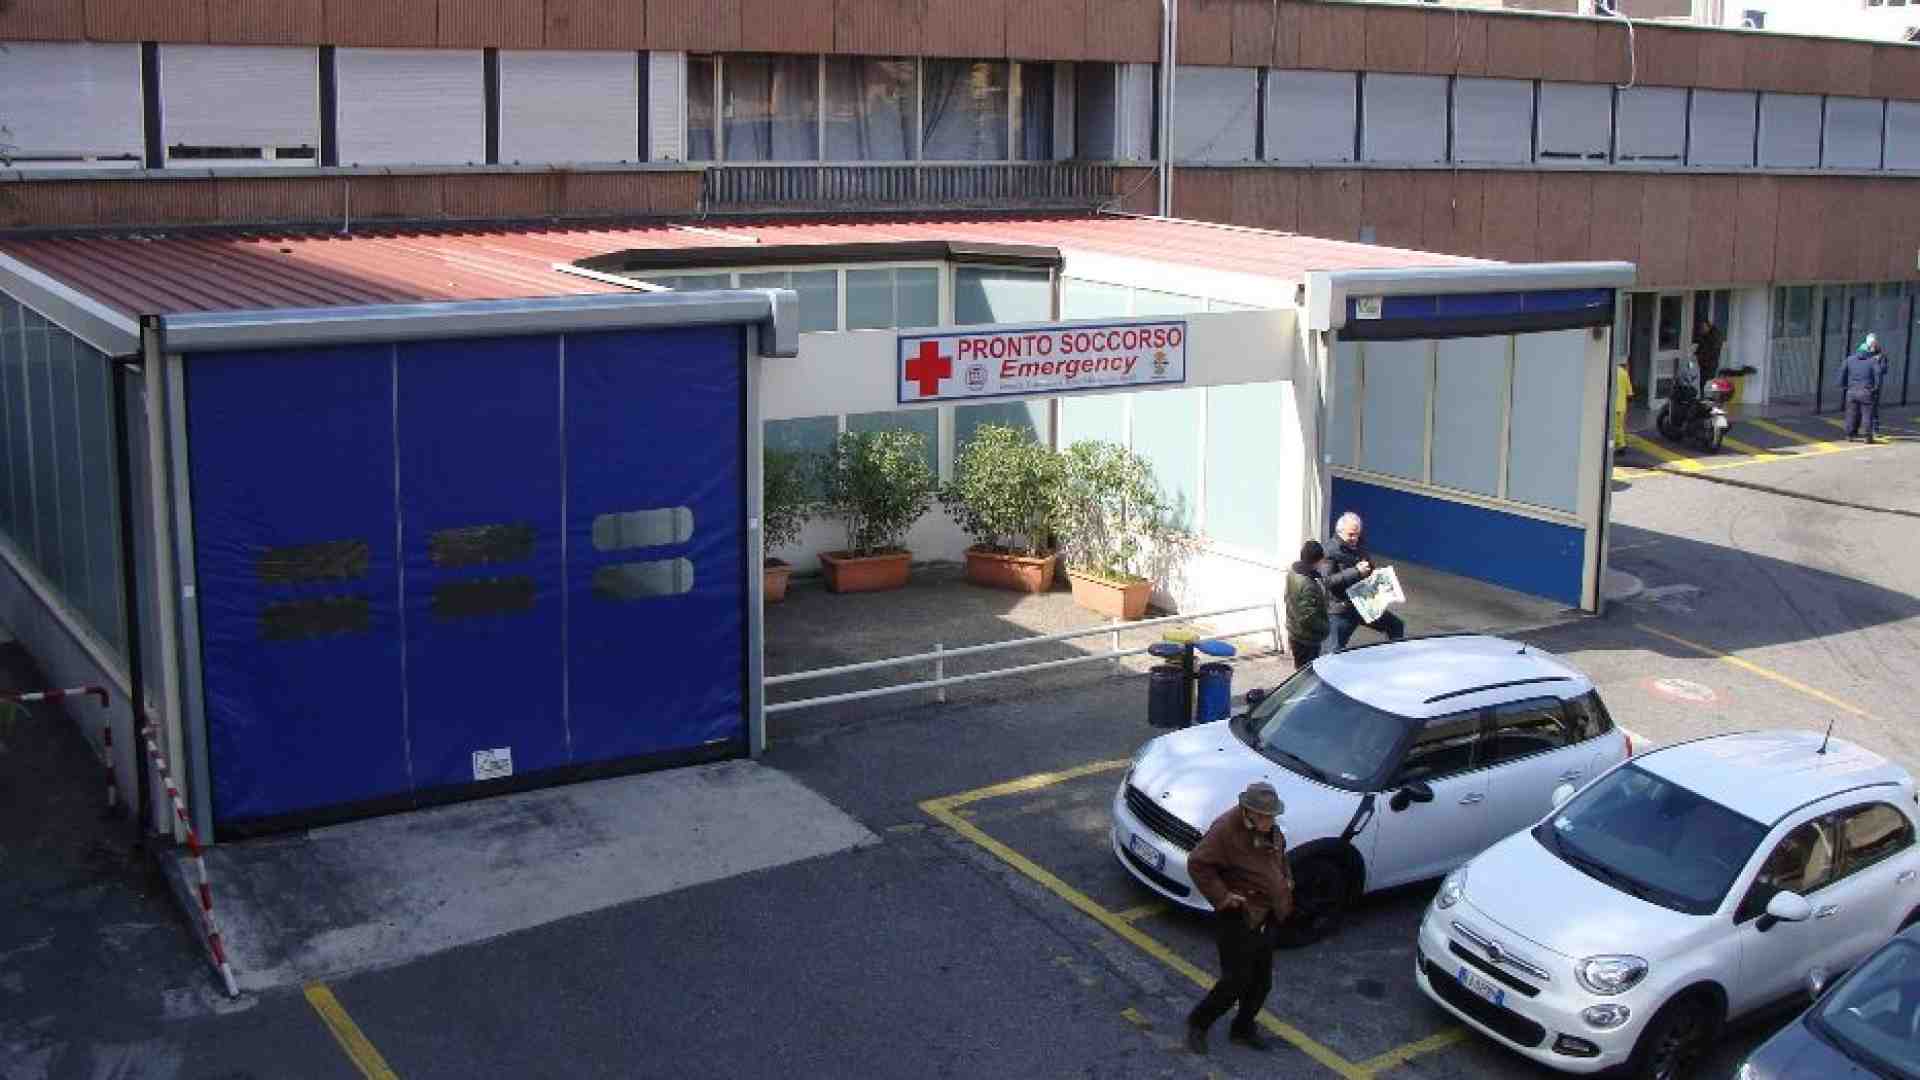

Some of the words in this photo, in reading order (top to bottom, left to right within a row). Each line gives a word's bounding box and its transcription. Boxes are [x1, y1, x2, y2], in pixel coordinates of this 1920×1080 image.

[957, 334, 1051, 361] PRONTO
[1059, 327, 1182, 355] SOCCORSO
[1000, 355, 1138, 379] Emergency
